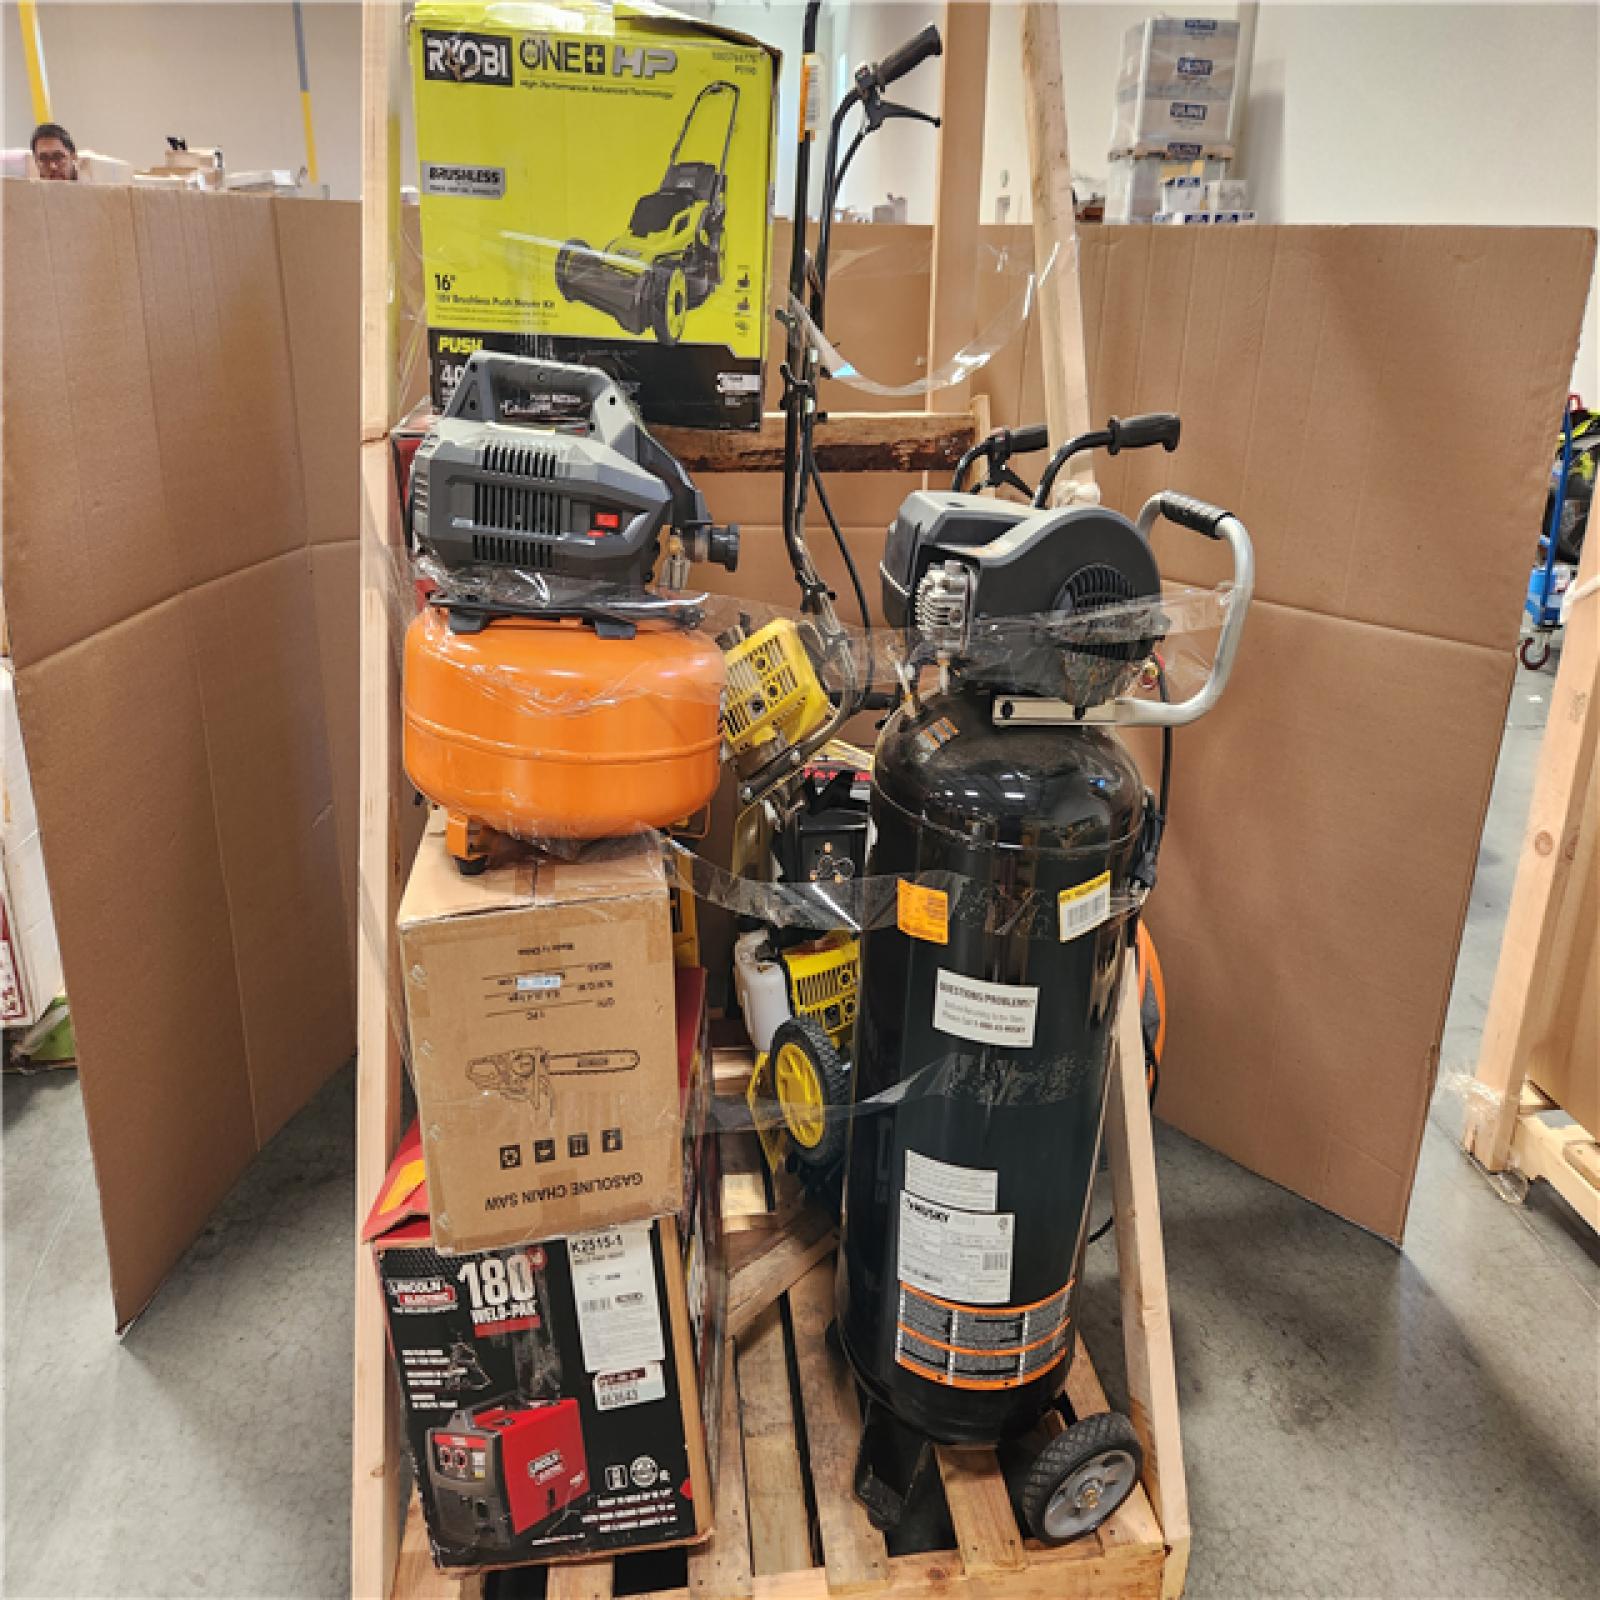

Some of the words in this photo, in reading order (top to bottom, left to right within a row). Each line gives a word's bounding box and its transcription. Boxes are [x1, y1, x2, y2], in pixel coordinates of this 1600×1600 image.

[425, 36, 509, 79] RYOBI
[612, 48, 678, 80] HP
[429, 166, 501, 185] BRUSHLESS
[438, 335, 484, 354] PUSH
[521, 1184, 568, 1202] CHAIN
[571, 1171, 644, 1196] GASOLINE
[484, 1193, 519, 1212] SAW
[457, 1254, 536, 1309] 180
